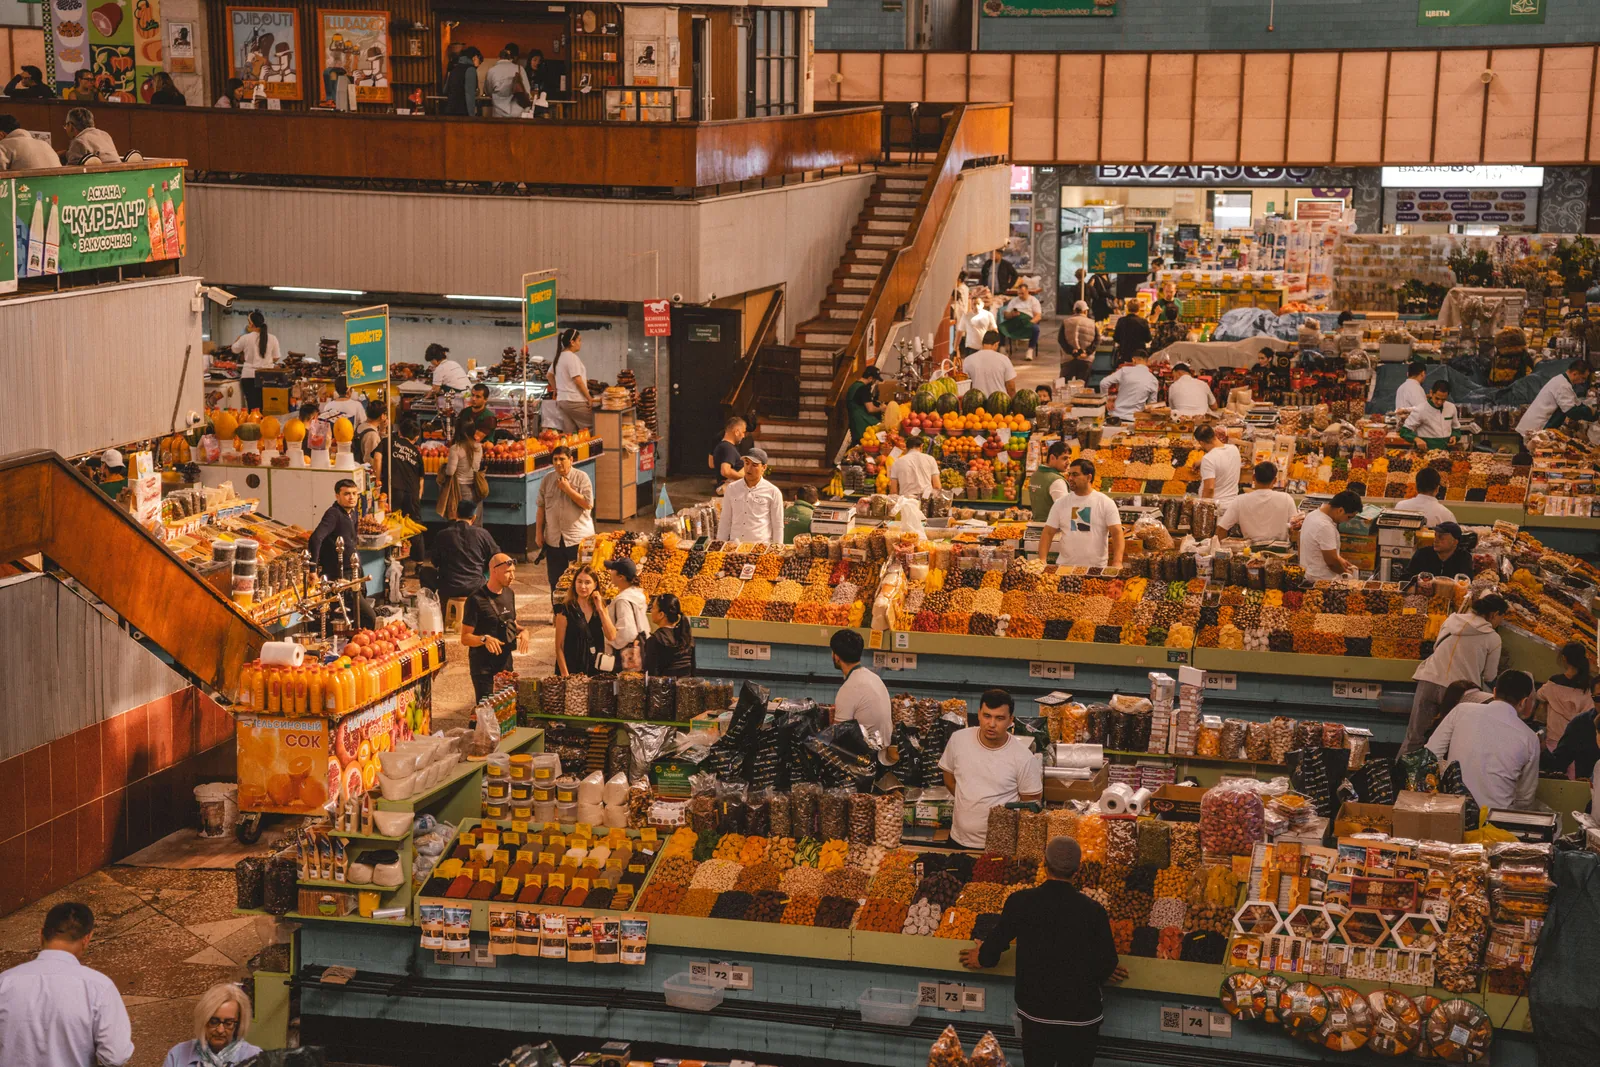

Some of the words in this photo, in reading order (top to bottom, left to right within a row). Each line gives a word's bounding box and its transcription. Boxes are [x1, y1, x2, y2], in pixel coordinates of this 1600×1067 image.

[1425, 9, 1450, 18] ЦВЕТЫ
[233, 12, 293, 27] DJIBOUTI
[88, 185, 122, 201] АСХАНА
[79, 233, 132, 252] ЗАКУСОЧНАЯ
[1351, 686, 1363, 694] 64
[286, 733, 322, 749] СОК
[714, 970, 728, 981] 72
[944, 992, 959, 1002] 73
[1188, 1017, 1204, 1028] 74
